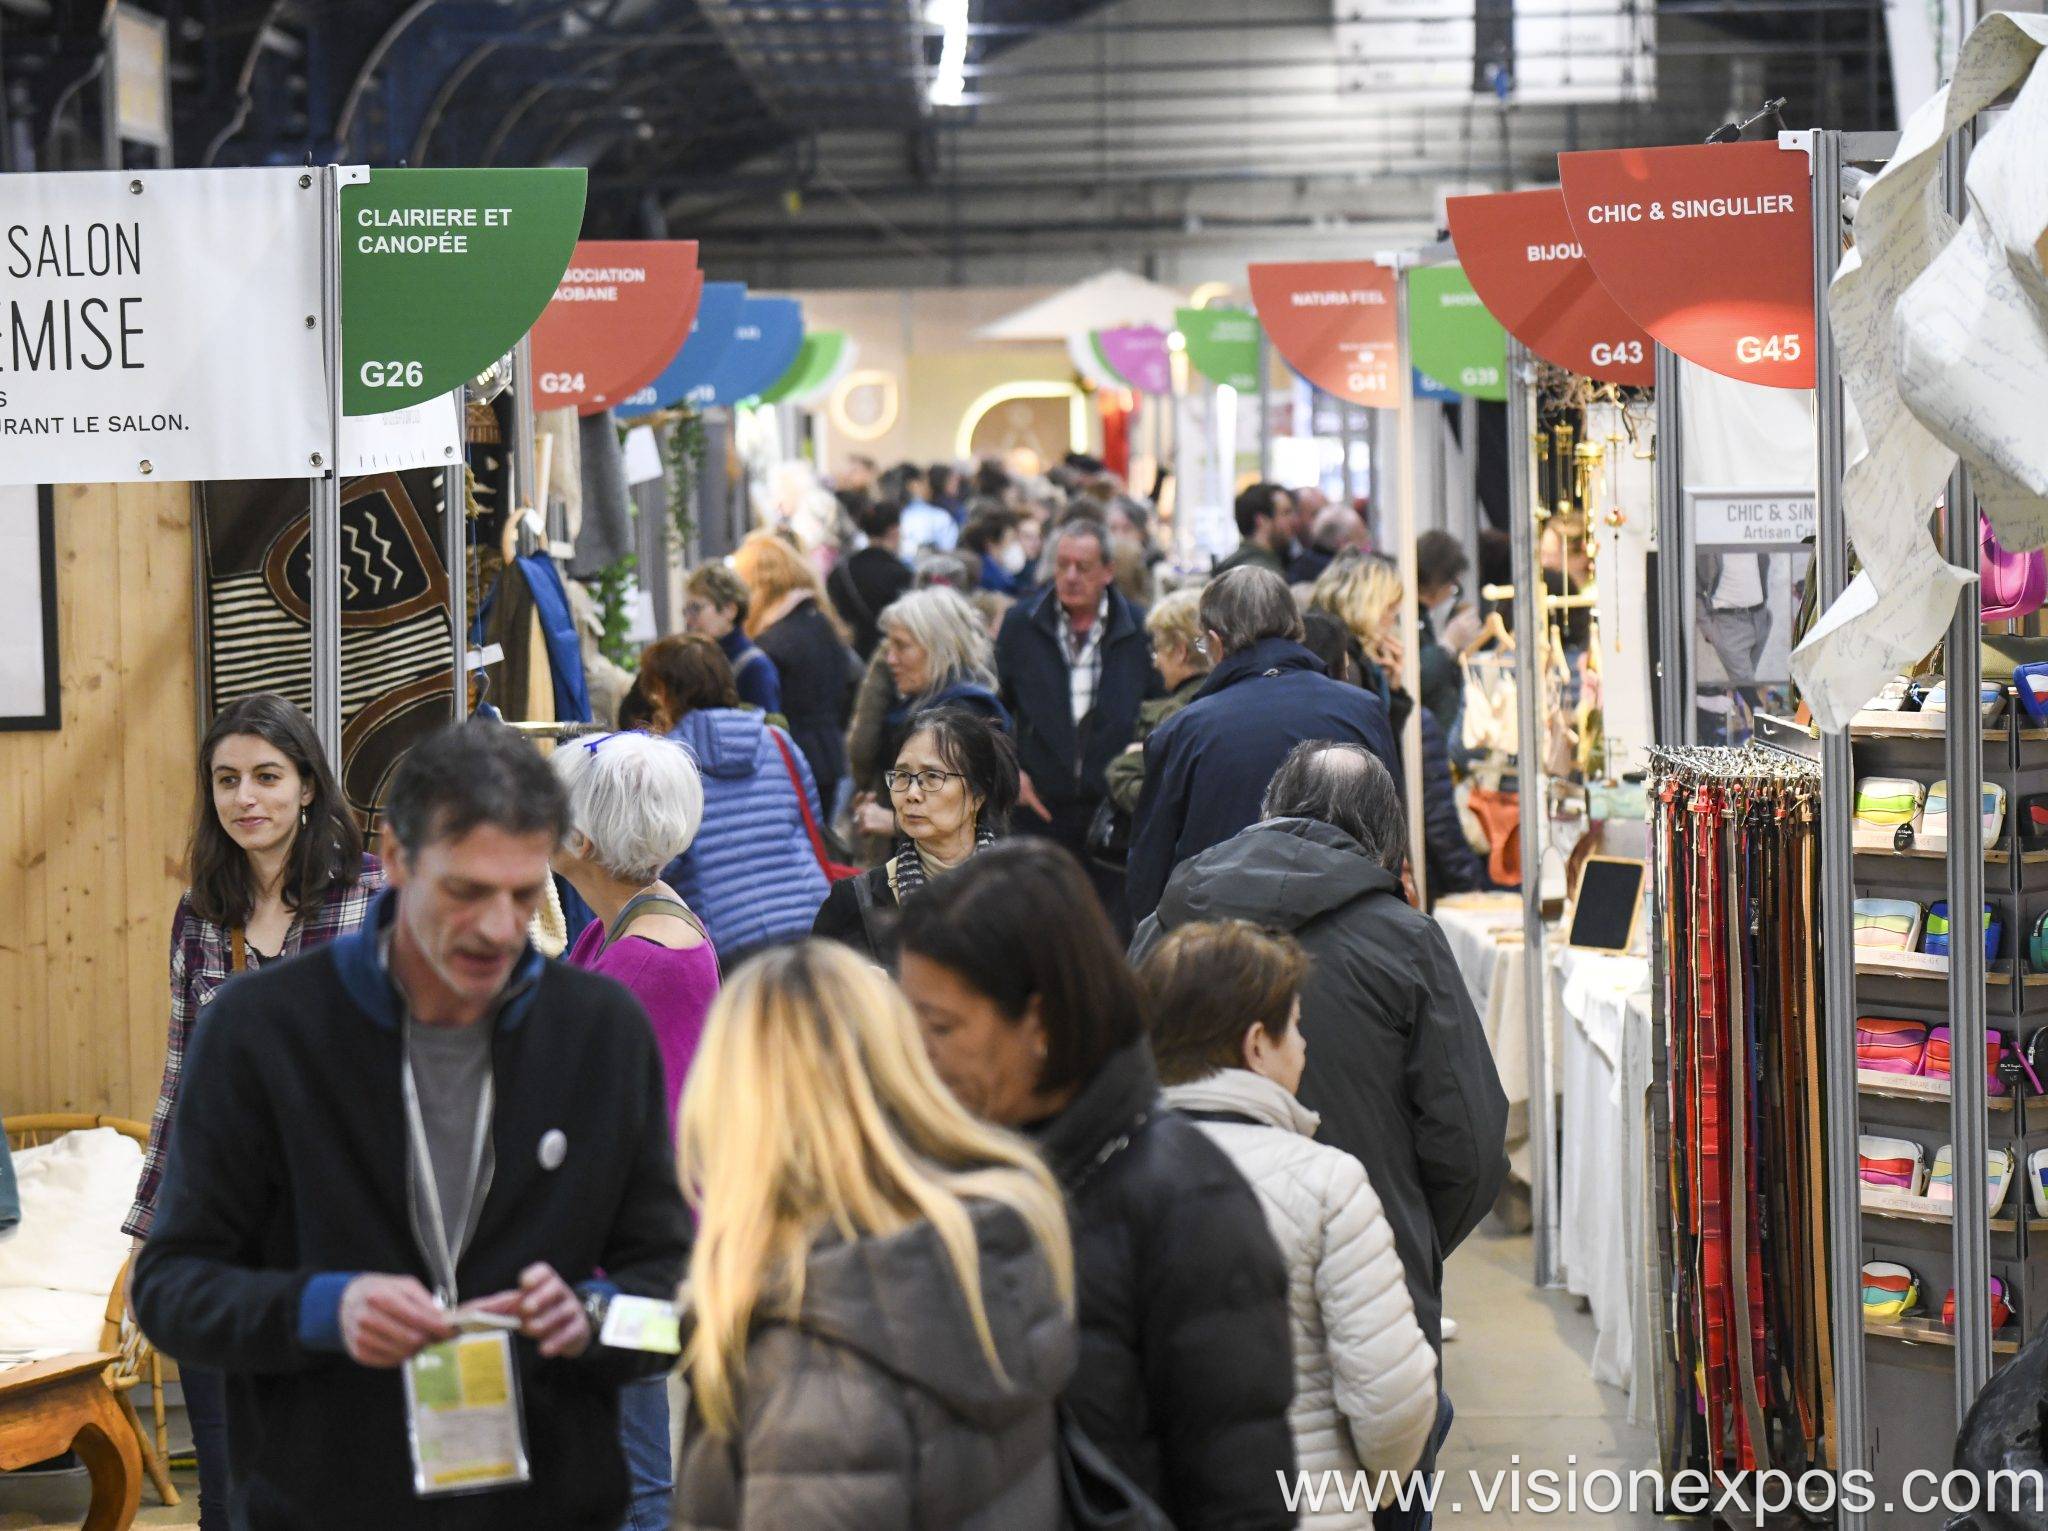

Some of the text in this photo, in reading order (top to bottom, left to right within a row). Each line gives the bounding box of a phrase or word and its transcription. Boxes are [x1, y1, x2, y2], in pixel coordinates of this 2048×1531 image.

[358, 208, 512, 227] CLAIRIERE ET
[1588, 194, 1794, 224] CHIC & SINGULIER
[7, 222, 141, 279] SALON
[358, 231, 468, 253] CANOPÉE
[1527, 242, 1586, 262] BIJOU
[0, 297, 145, 372] MISE
[1591, 341, 1643, 366] G43
[1736, 334, 1801, 364] G45
[360, 361, 424, 388] G26
[539, 372, 586, 394] G24
[0, 414, 190, 434] RANT LE SALON.
[1727, 504, 1762, 522] CHIC
[1769, 503, 1782, 521] &
[1744, 525, 1791, 539] Artisan
